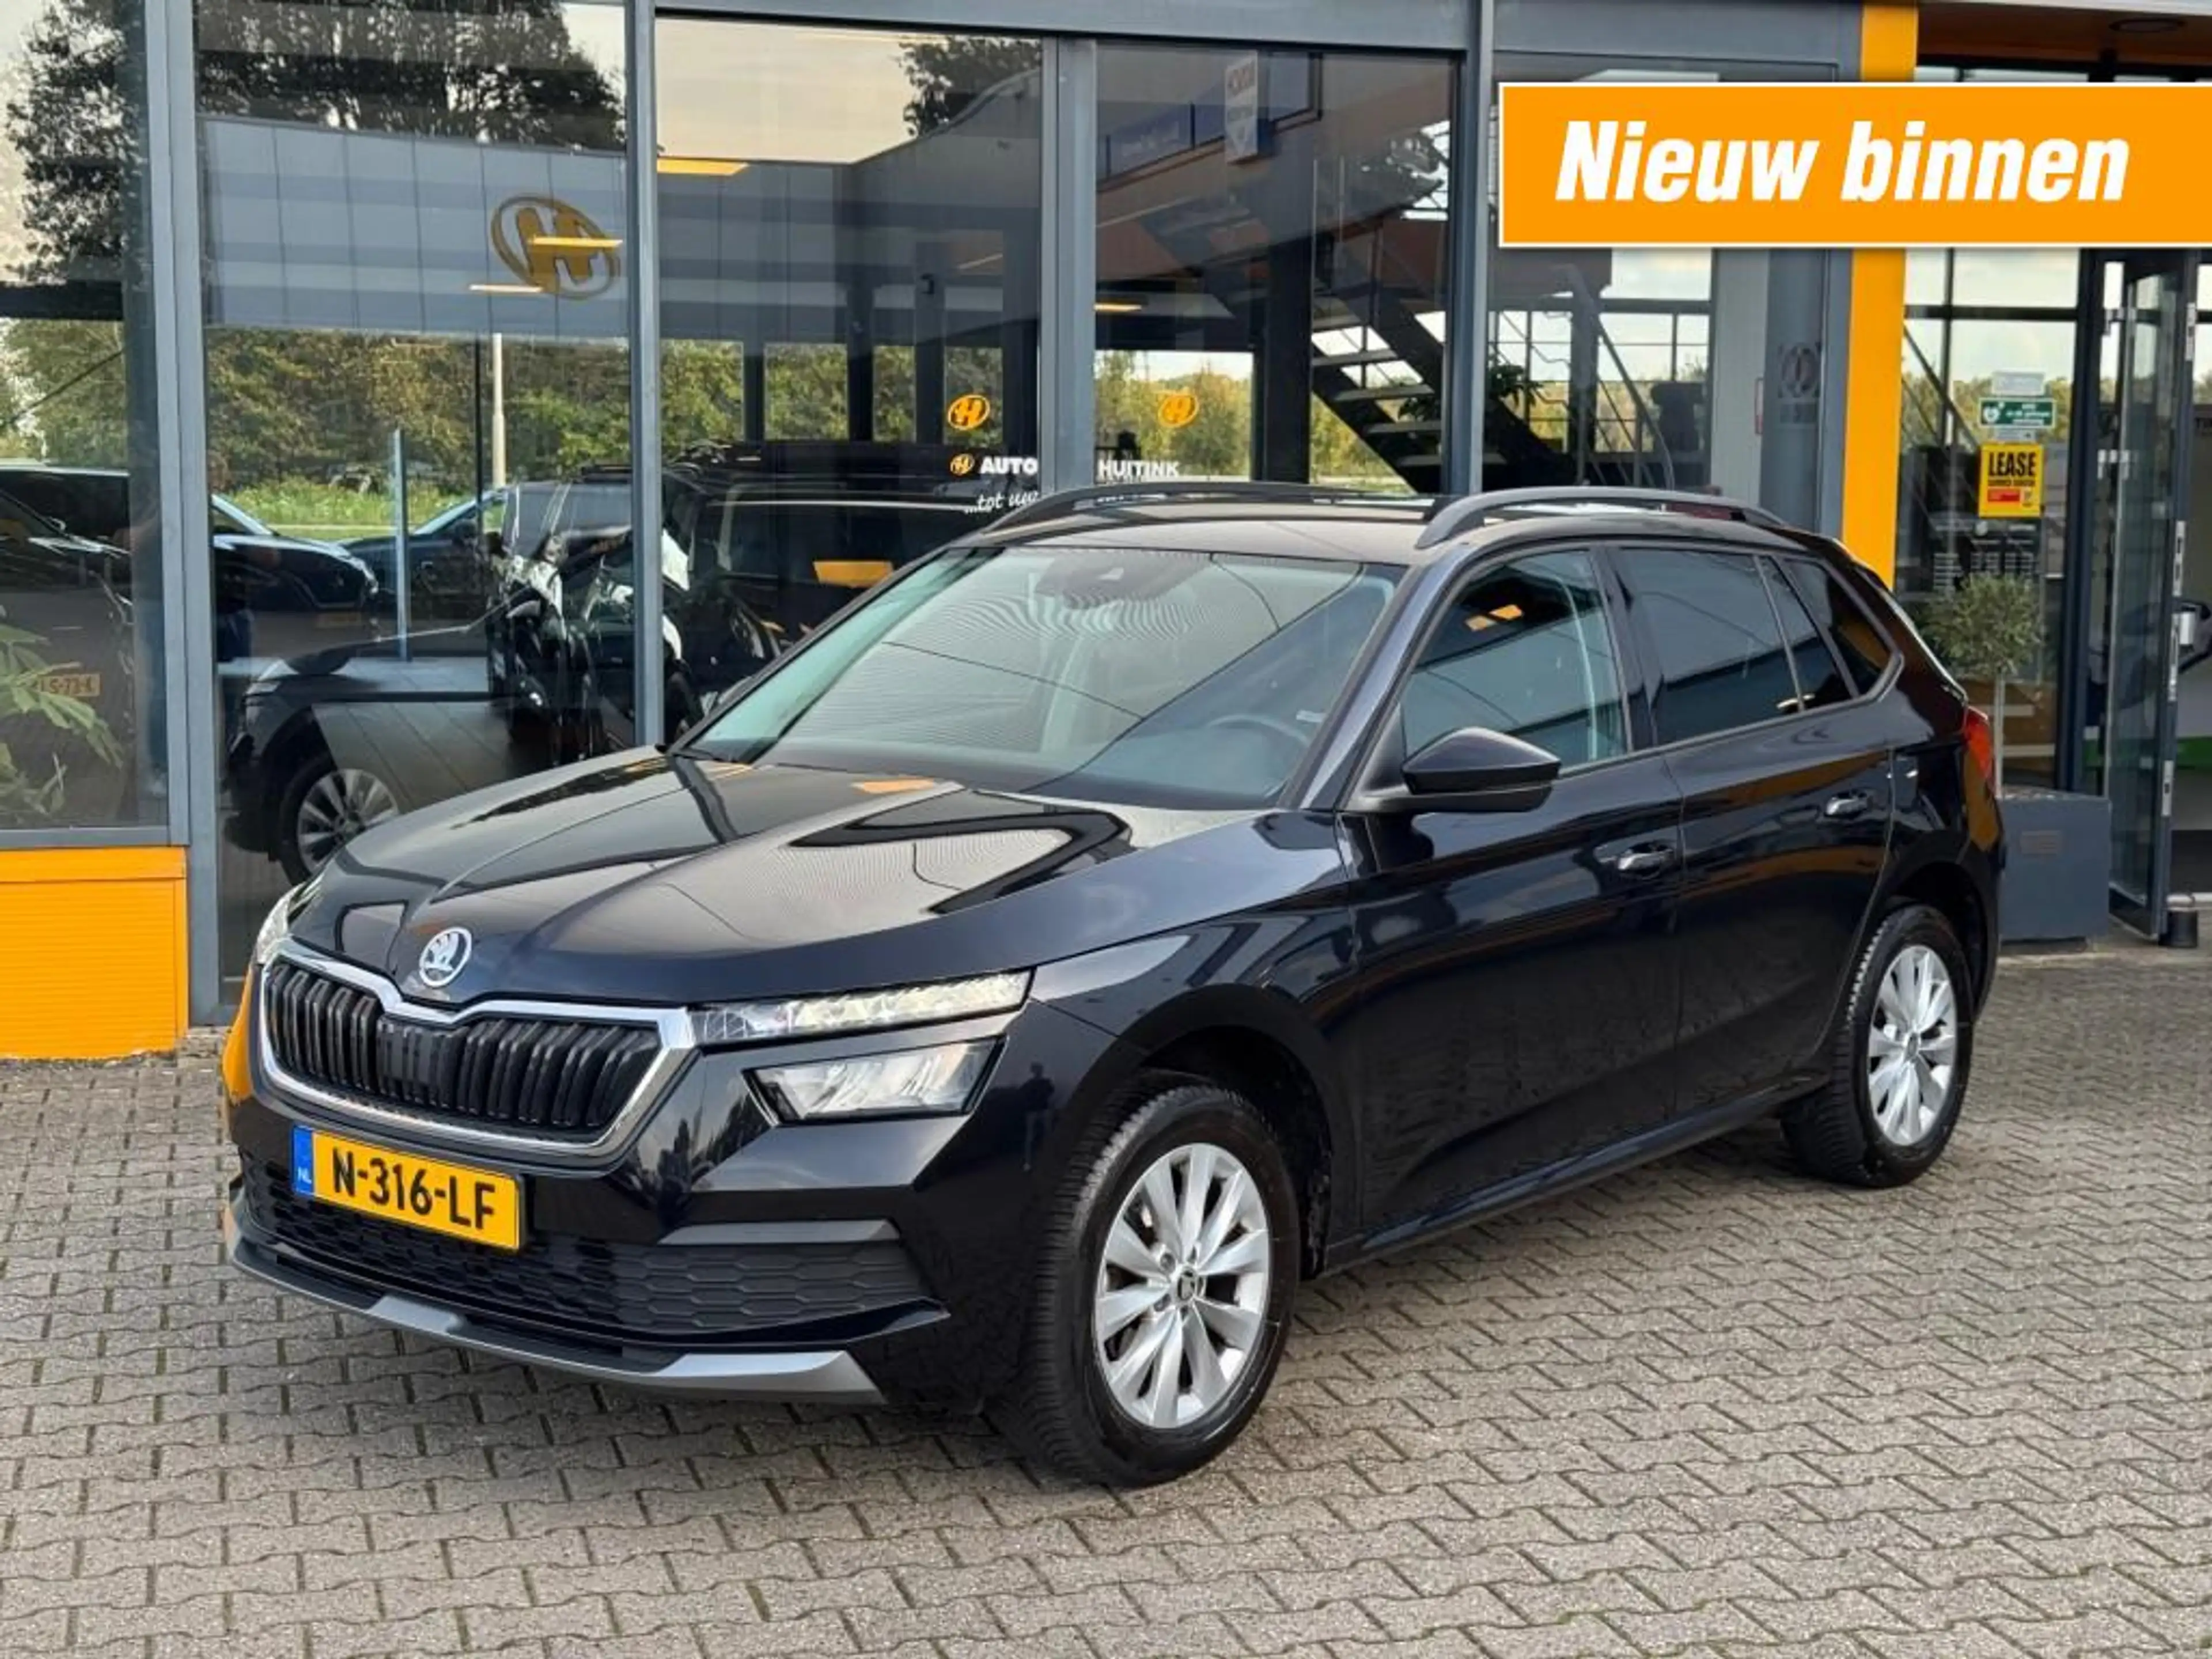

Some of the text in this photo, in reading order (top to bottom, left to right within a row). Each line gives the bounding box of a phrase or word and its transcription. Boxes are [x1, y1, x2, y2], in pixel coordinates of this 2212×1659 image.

[980, 457, 1039, 475] AUTO
[1097, 459, 1179, 479] HUITINK
[1988, 451, 2037, 476] LEASE
[298, 1166, 312, 1185] NL
[332, 1147, 497, 1229] N-316-LF
